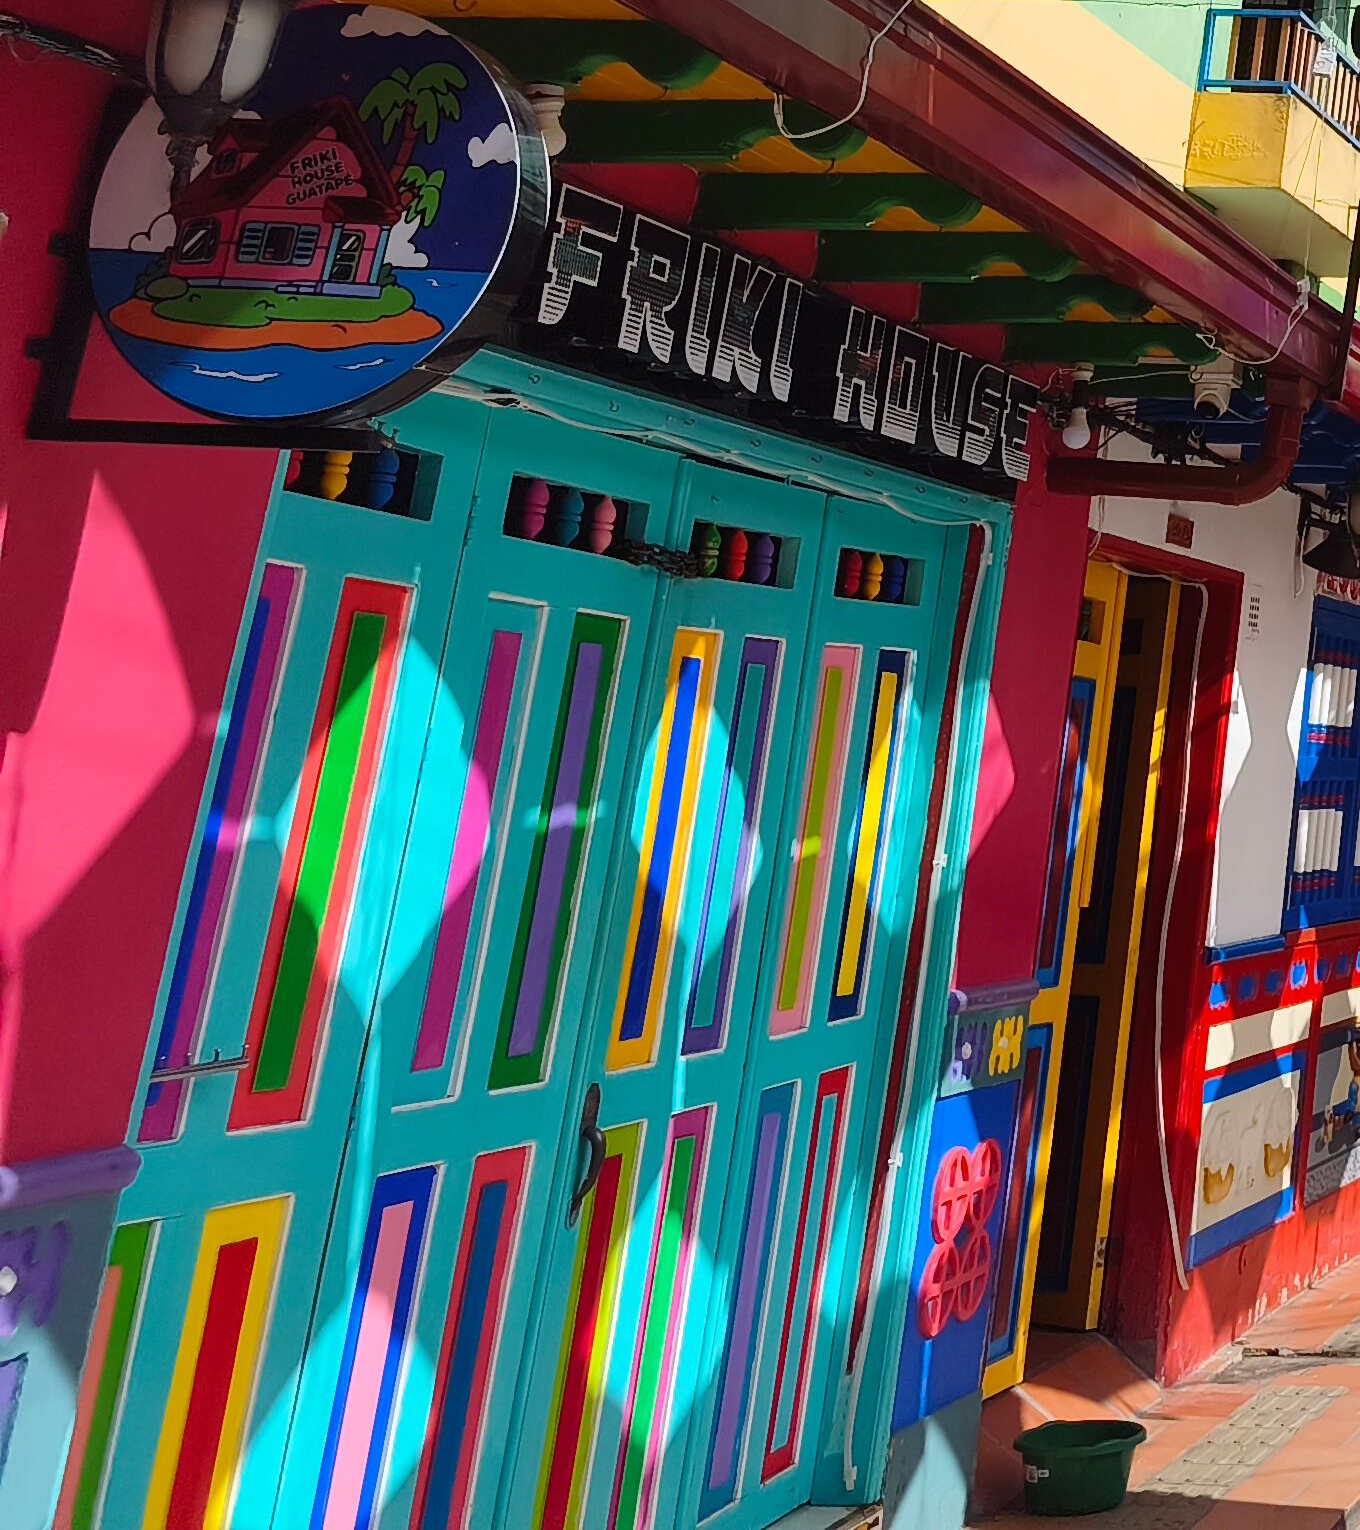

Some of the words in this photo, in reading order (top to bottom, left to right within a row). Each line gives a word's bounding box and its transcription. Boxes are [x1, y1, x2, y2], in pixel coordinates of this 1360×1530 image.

[289, 147, 338, 175] FRIKI
[291, 161, 345, 189] HOUSE
[285, 172, 354, 206] GUATAPÉ
[537, 182, 803, 403] FRIKI
[832, 305, 1041, 483] HOUSE
